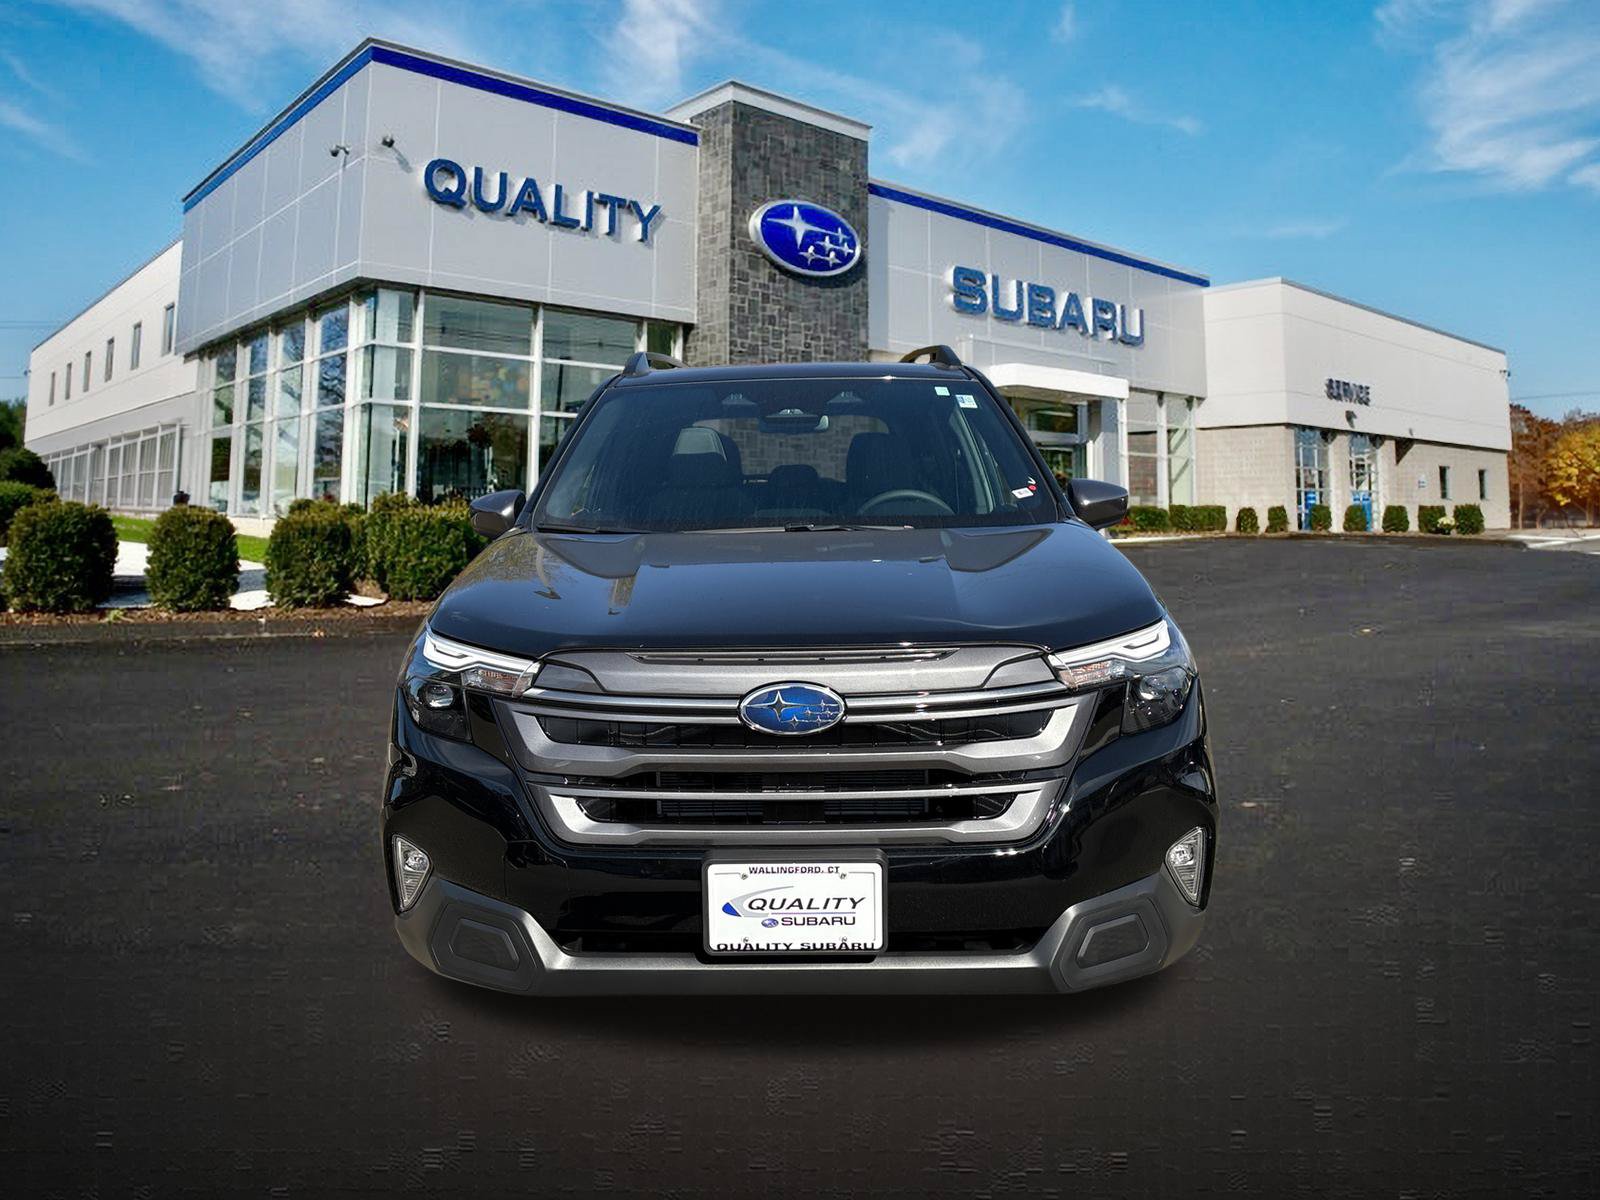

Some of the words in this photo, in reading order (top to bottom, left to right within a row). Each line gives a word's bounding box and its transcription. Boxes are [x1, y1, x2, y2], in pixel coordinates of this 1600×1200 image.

[424, 158, 662, 243] QUALITY
[950, 265, 1145, 346] SUBARU
[748, 897, 866, 911] QUALITY
[781, 916, 856, 926] SUBARU
[716, 942, 792, 951] QUALITY
[800, 942, 875, 951] SUBARU
